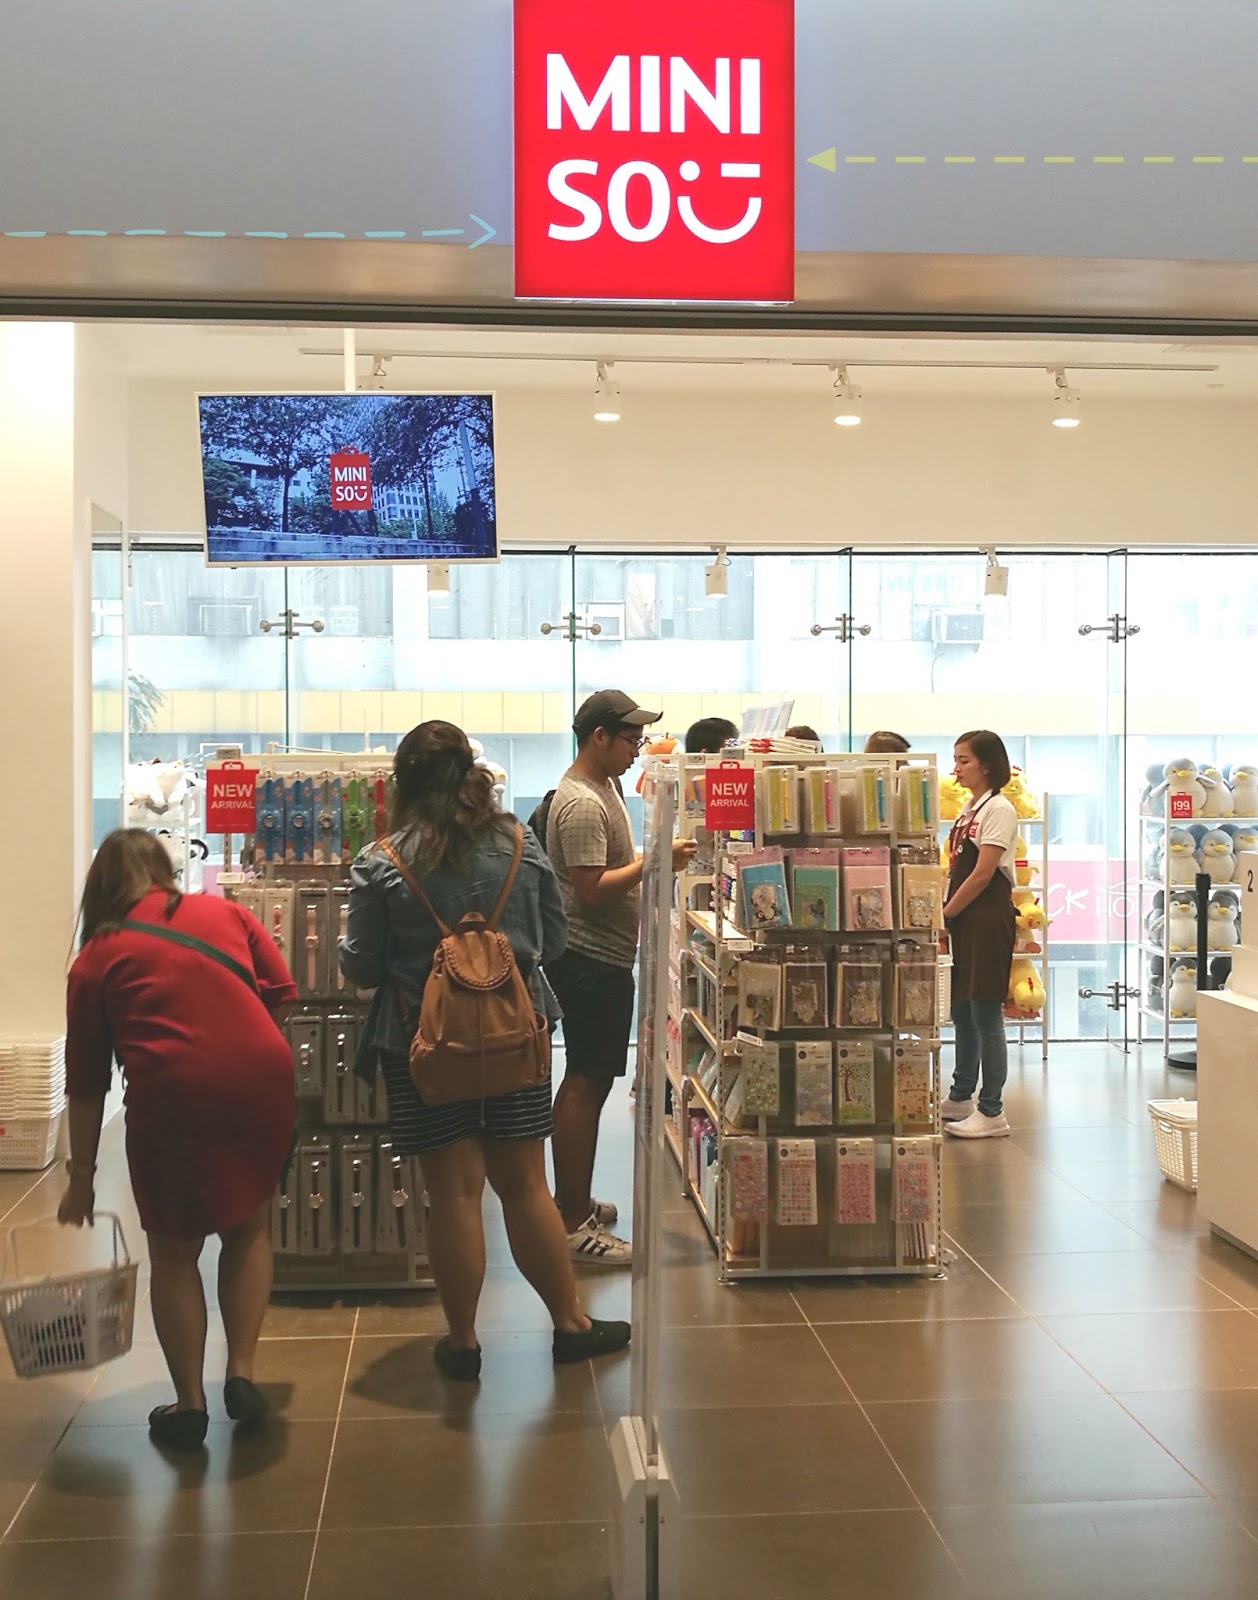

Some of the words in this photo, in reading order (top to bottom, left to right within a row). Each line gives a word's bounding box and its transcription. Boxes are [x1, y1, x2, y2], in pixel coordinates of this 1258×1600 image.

[546, 53, 761, 134] MINI
[334, 466, 367, 482] MINI
[213, 784, 253, 798] NEW
[711, 782, 748, 796] NEW
[210, 800, 255, 809] ARRIVAL
[709, 798, 749, 807] ARRIVAL
[1247, 869, 1254, 893] 2
